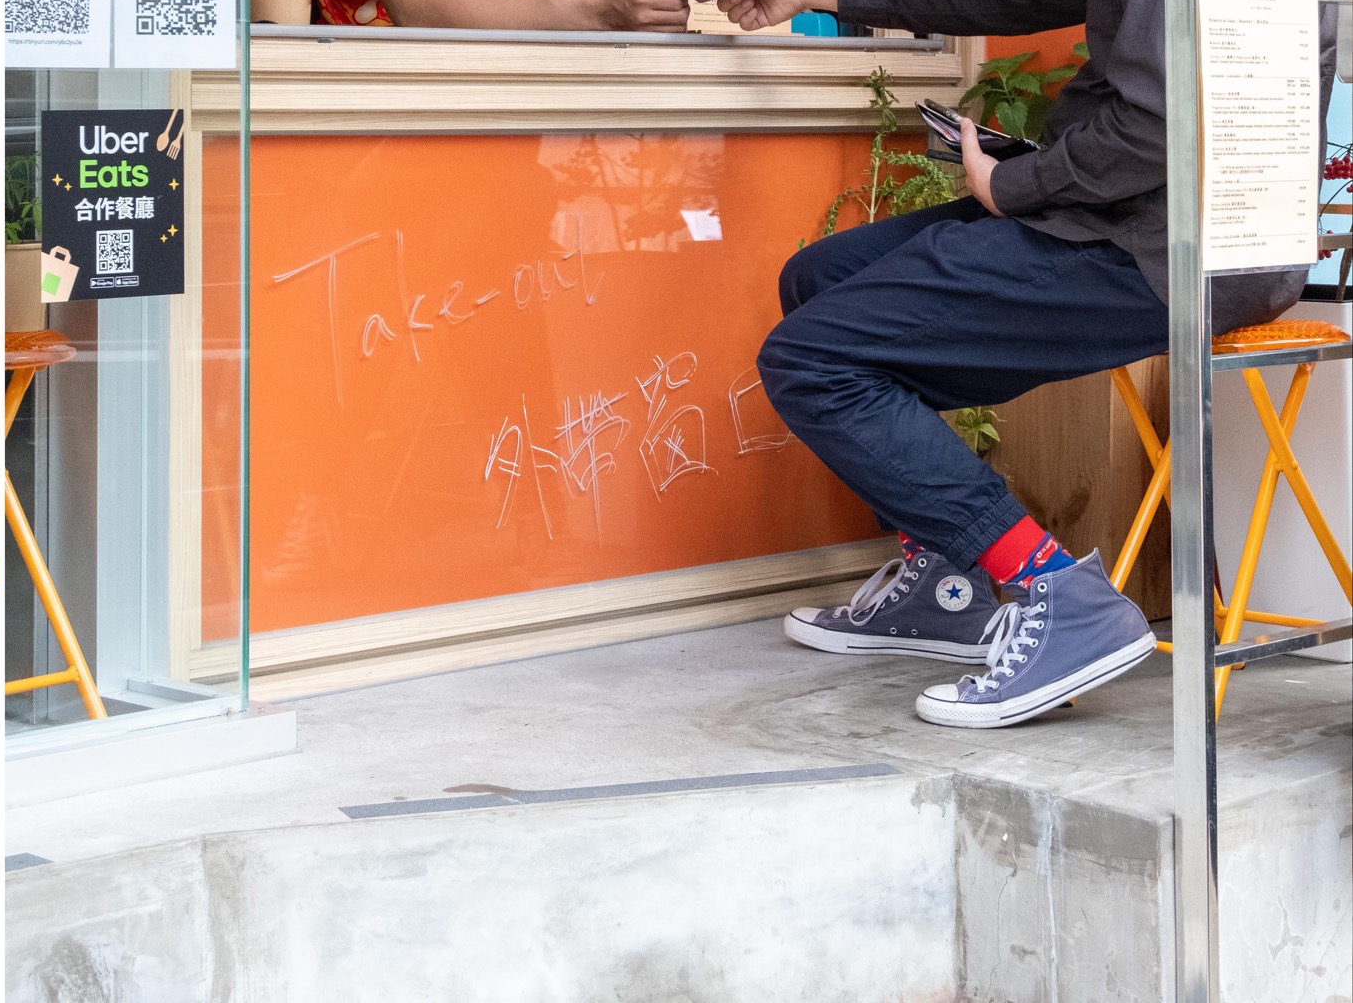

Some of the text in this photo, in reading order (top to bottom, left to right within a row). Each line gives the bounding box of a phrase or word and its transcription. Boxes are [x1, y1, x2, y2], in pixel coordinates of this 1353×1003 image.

[79, 125, 149, 154] Uber
[79, 159, 149, 189] Eats
[74, 196, 155, 222] 合作餐廳
[273, 212, 606, 410] Take-out
